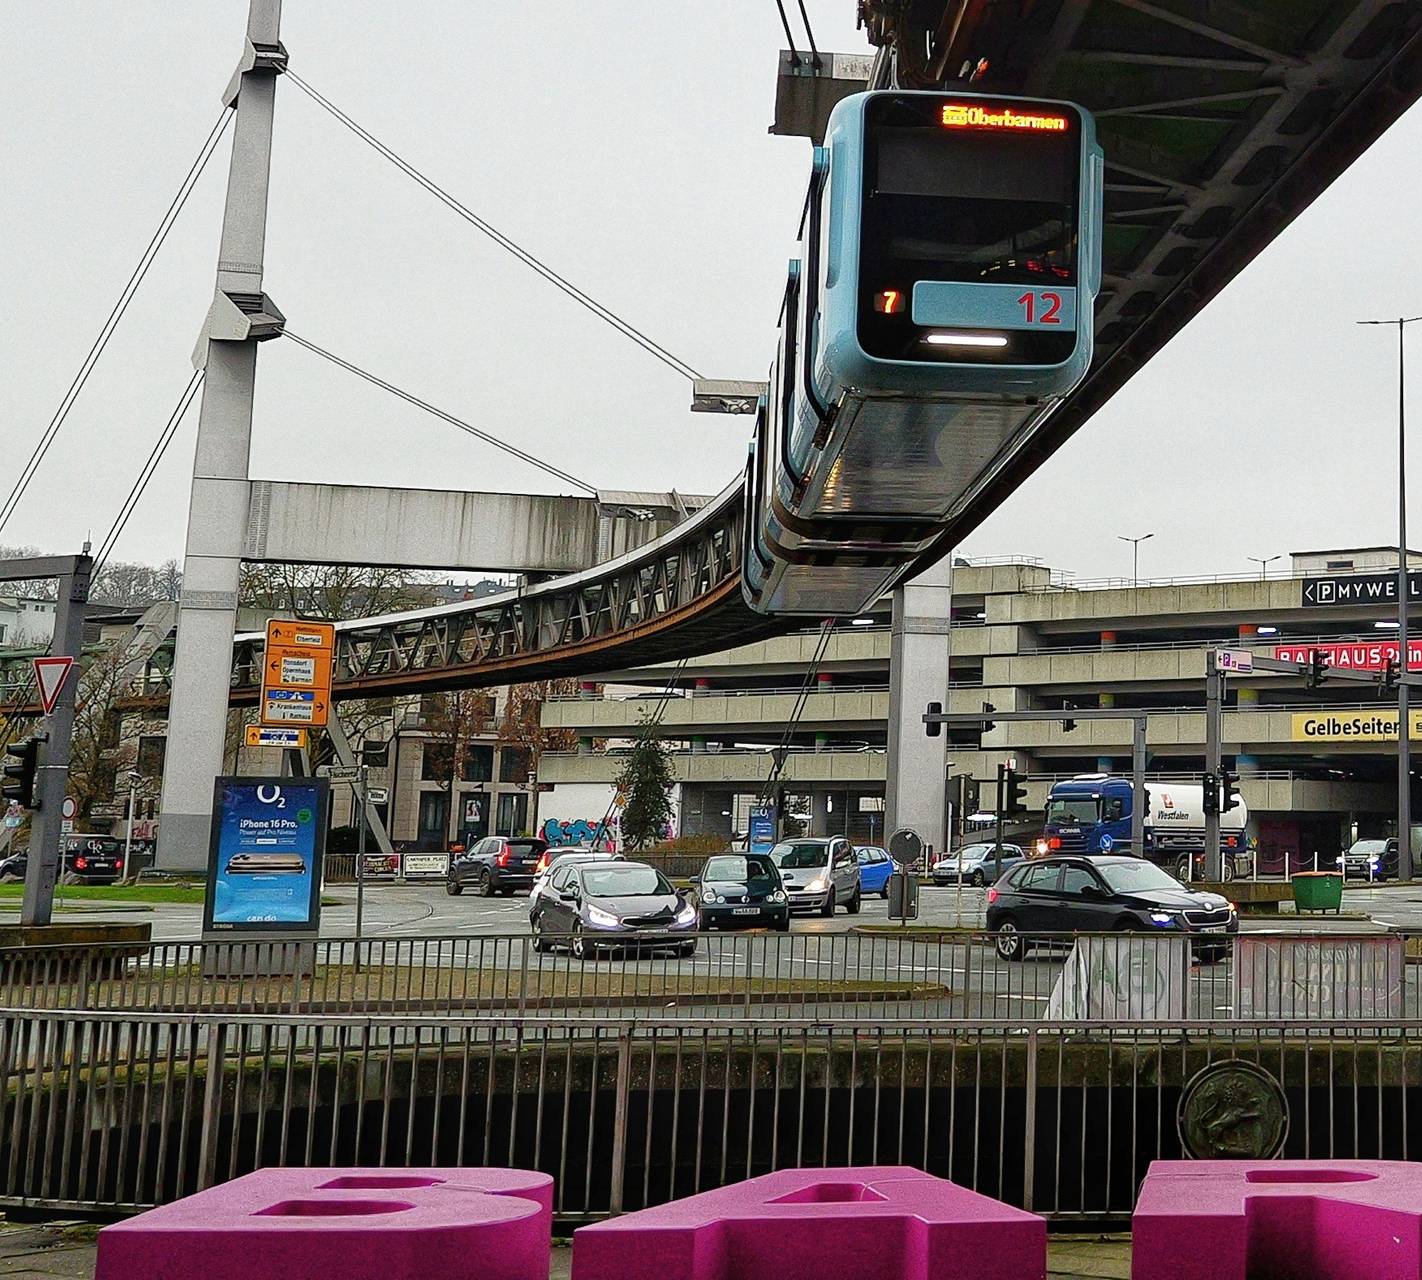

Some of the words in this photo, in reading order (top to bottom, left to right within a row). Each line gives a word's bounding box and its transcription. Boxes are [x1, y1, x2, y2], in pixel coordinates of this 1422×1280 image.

[883, 291, 897, 314] 7
[1017, 291, 1062, 324] 12
[1408, 645, 1422, 662] in
[240, 818, 270, 829] iPhone
[270, 819, 280, 829] 16
[281, 819, 298, 829] Pro.
[1156, 810, 1190, 821] Westfalen
